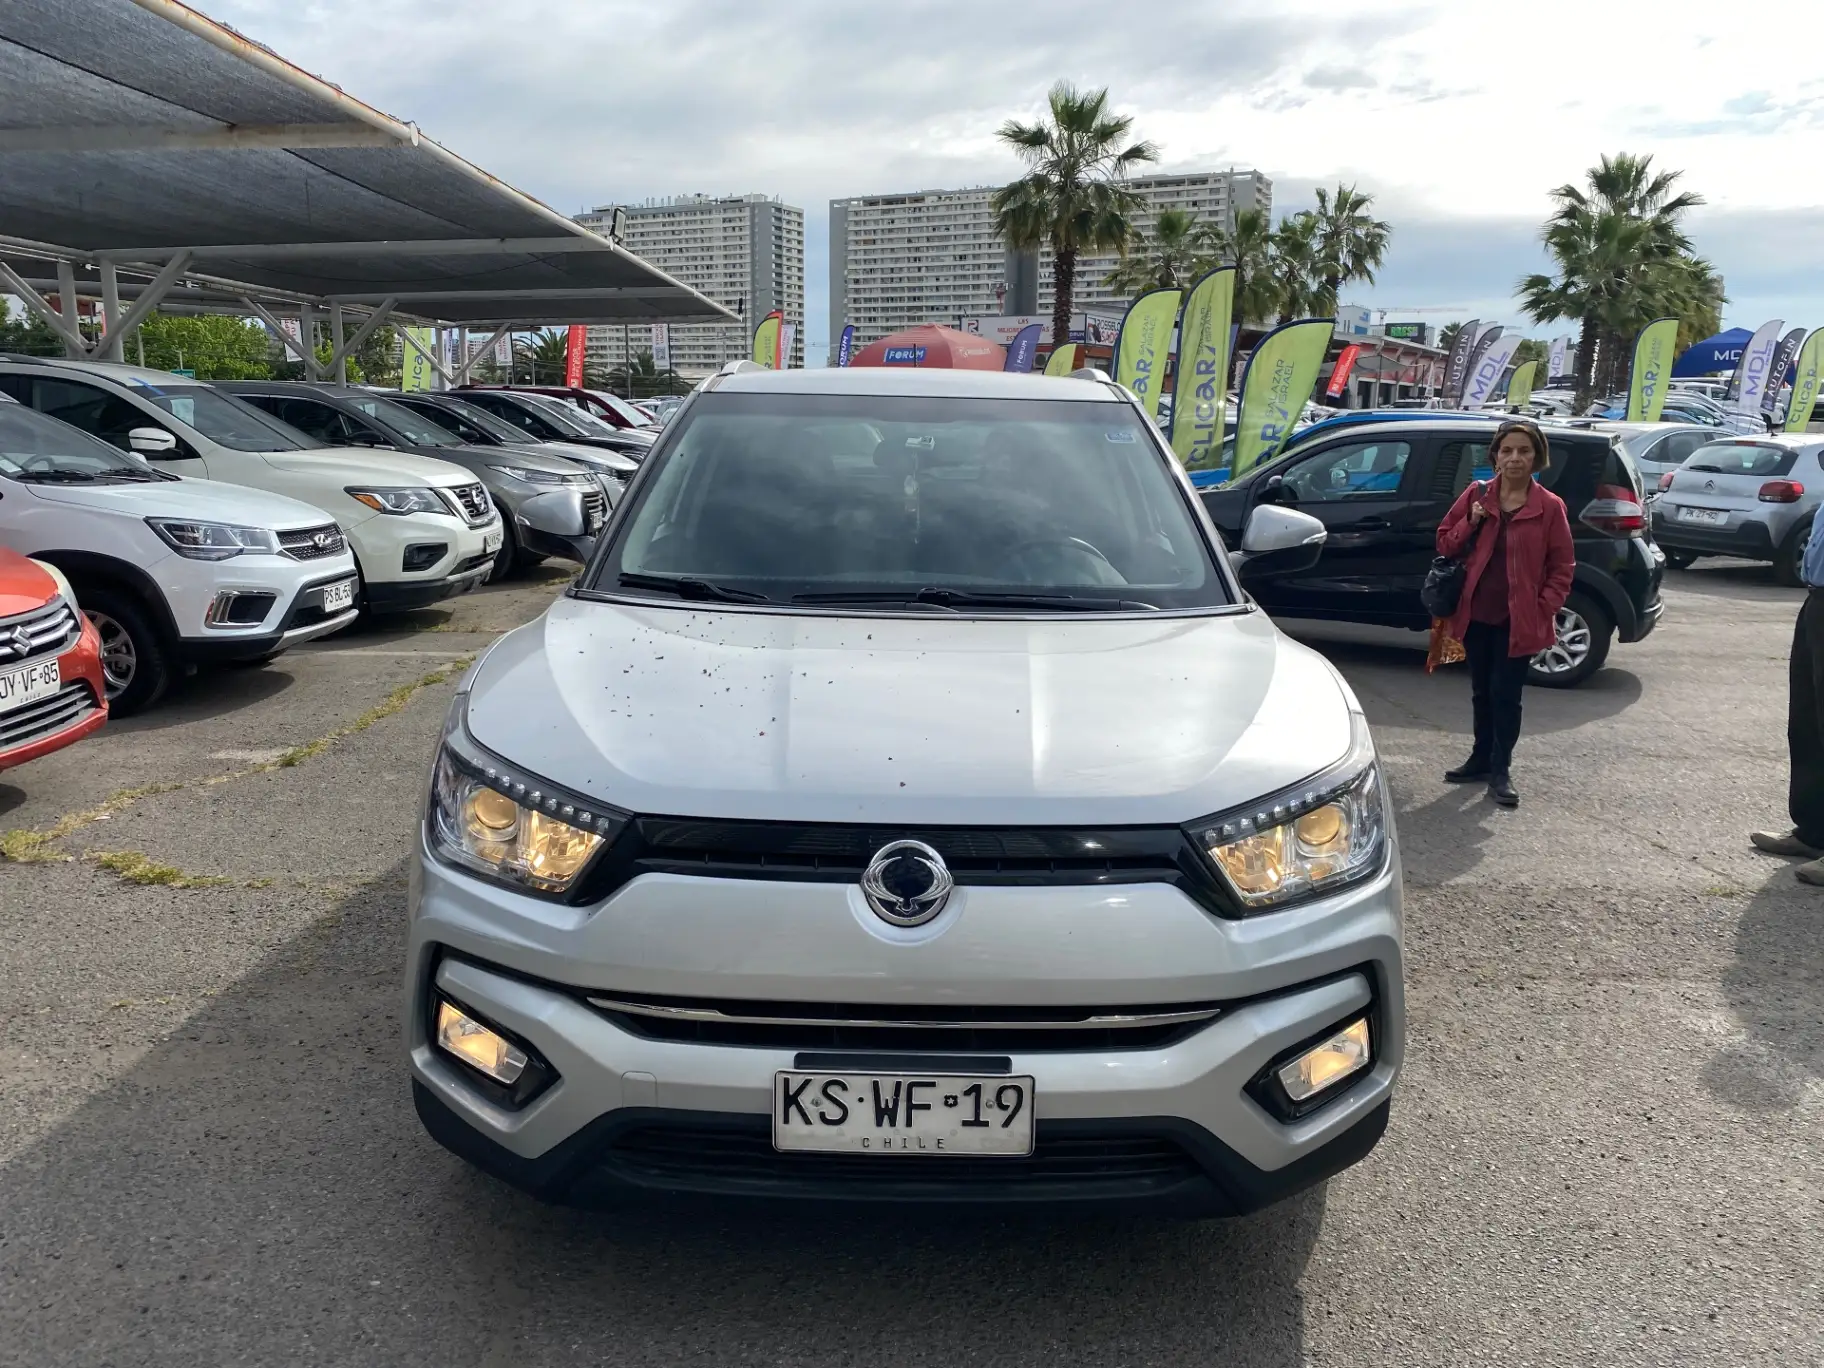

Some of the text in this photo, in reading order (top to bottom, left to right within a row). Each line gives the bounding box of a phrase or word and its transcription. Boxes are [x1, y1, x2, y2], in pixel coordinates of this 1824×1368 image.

[840, 336, 848, 367] ORUM
[888, 349, 925, 360] FORUM
[1017, 340, 1028, 363] FORUM
[1551, 345, 1565, 377] MDL
[1745, 340, 1771, 395] MDL
[1767, 338, 1796, 397] AUTOFIN
[1265, 358, 1285, 418] SALAZAR
[1277, 360, 1295, 405] ISRAEL
[1470, 350, 1507, 400] MDL
[862, 1136, 945, 1149] CHILE
